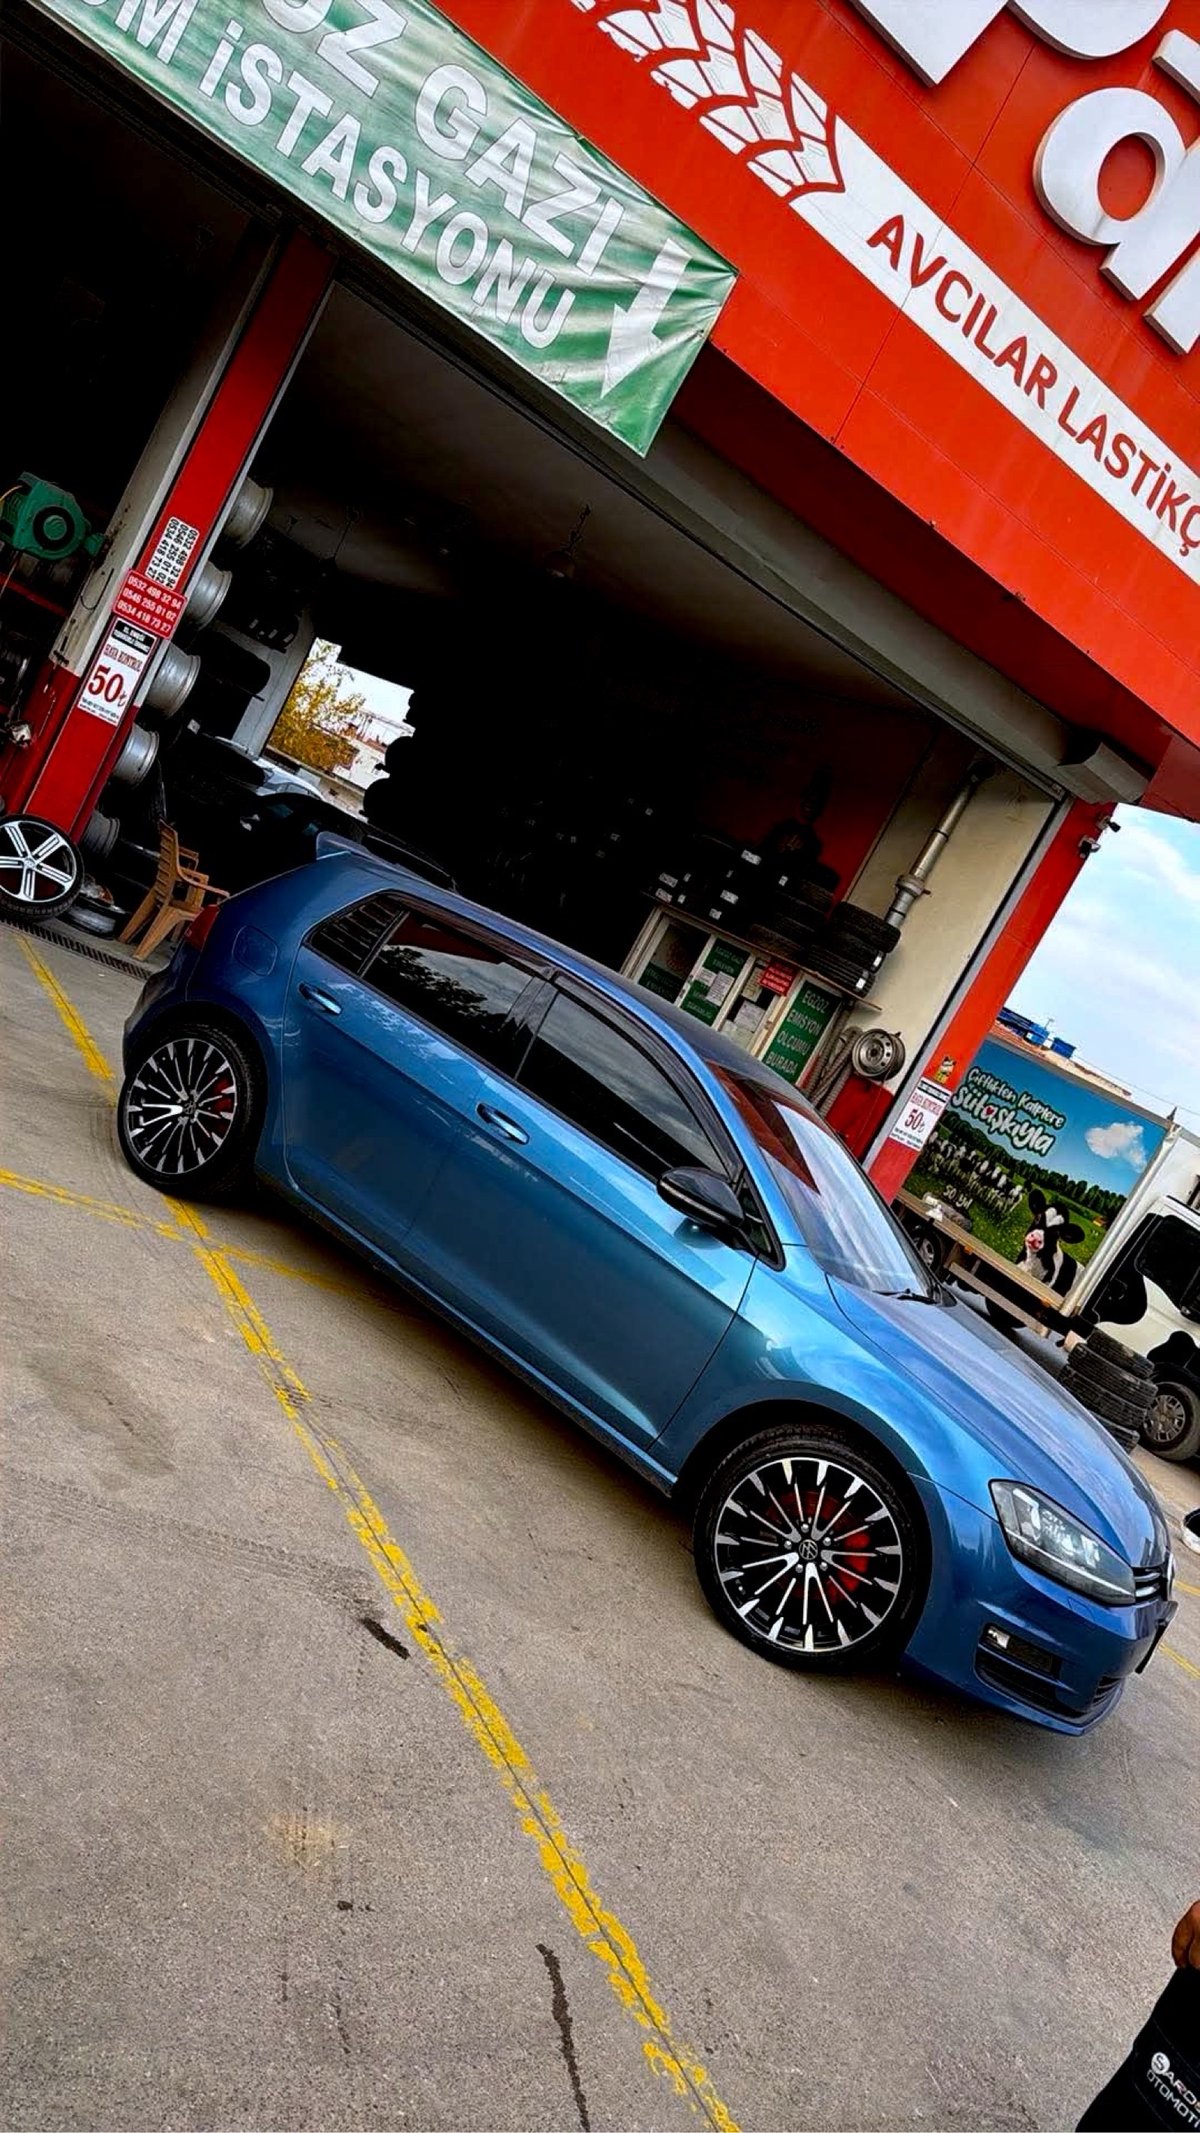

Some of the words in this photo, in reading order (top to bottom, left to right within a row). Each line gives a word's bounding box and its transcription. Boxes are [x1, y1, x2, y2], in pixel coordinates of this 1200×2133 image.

[866, 214, 1058, 410] AVCILAR
[165, 518, 179, 540] 0534
[173, 523, 189, 545] 0546
[157, 539, 169, 555] 418
[183, 529, 197, 550] 0532
[151, 556, 162, 567] 73
[166, 544, 179, 561] 255
[175, 550, 187, 566] 498
[147, 567, 157, 579] 27
[161, 560, 172, 572] 01
[170, 566, 181, 578] 32
[155, 572, 167, 584] 02
[128, 575, 148, 591] 0532
[161, 592, 172, 605] 32
[170, 598, 182, 609] 94
[117, 600, 137, 616] 0534
[136, 610, 151, 623] 418
[150, 617, 161, 629] 73
[160, 622, 172, 633] 27
[141, 597, 156, 611] 255
[155, 605, 166, 616] 01
[165, 610, 177, 622] 02
[1018, 1093, 1064, 1128] Kalplere
